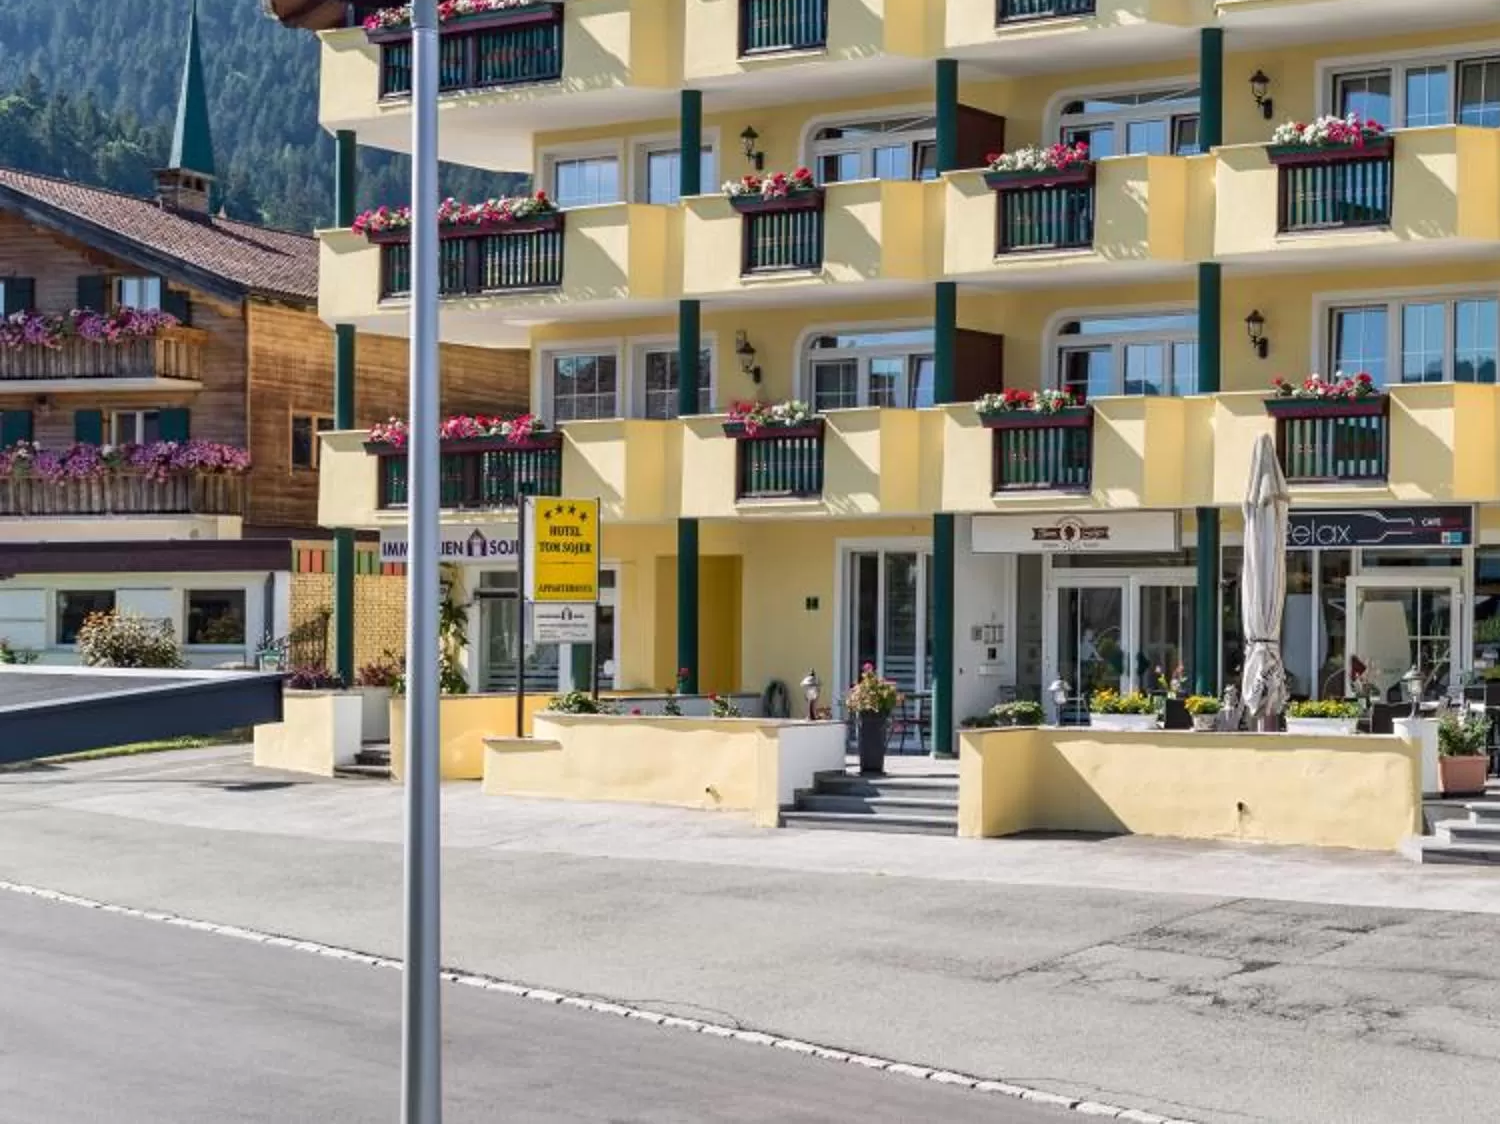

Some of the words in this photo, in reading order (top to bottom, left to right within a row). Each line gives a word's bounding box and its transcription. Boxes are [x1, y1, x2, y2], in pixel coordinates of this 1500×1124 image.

[549, 525, 583, 537] HOTEL
[383, 540, 463, 557] IMMIEN
[539, 541, 561, 553] TOM
[562, 541, 592, 556] SOJER
